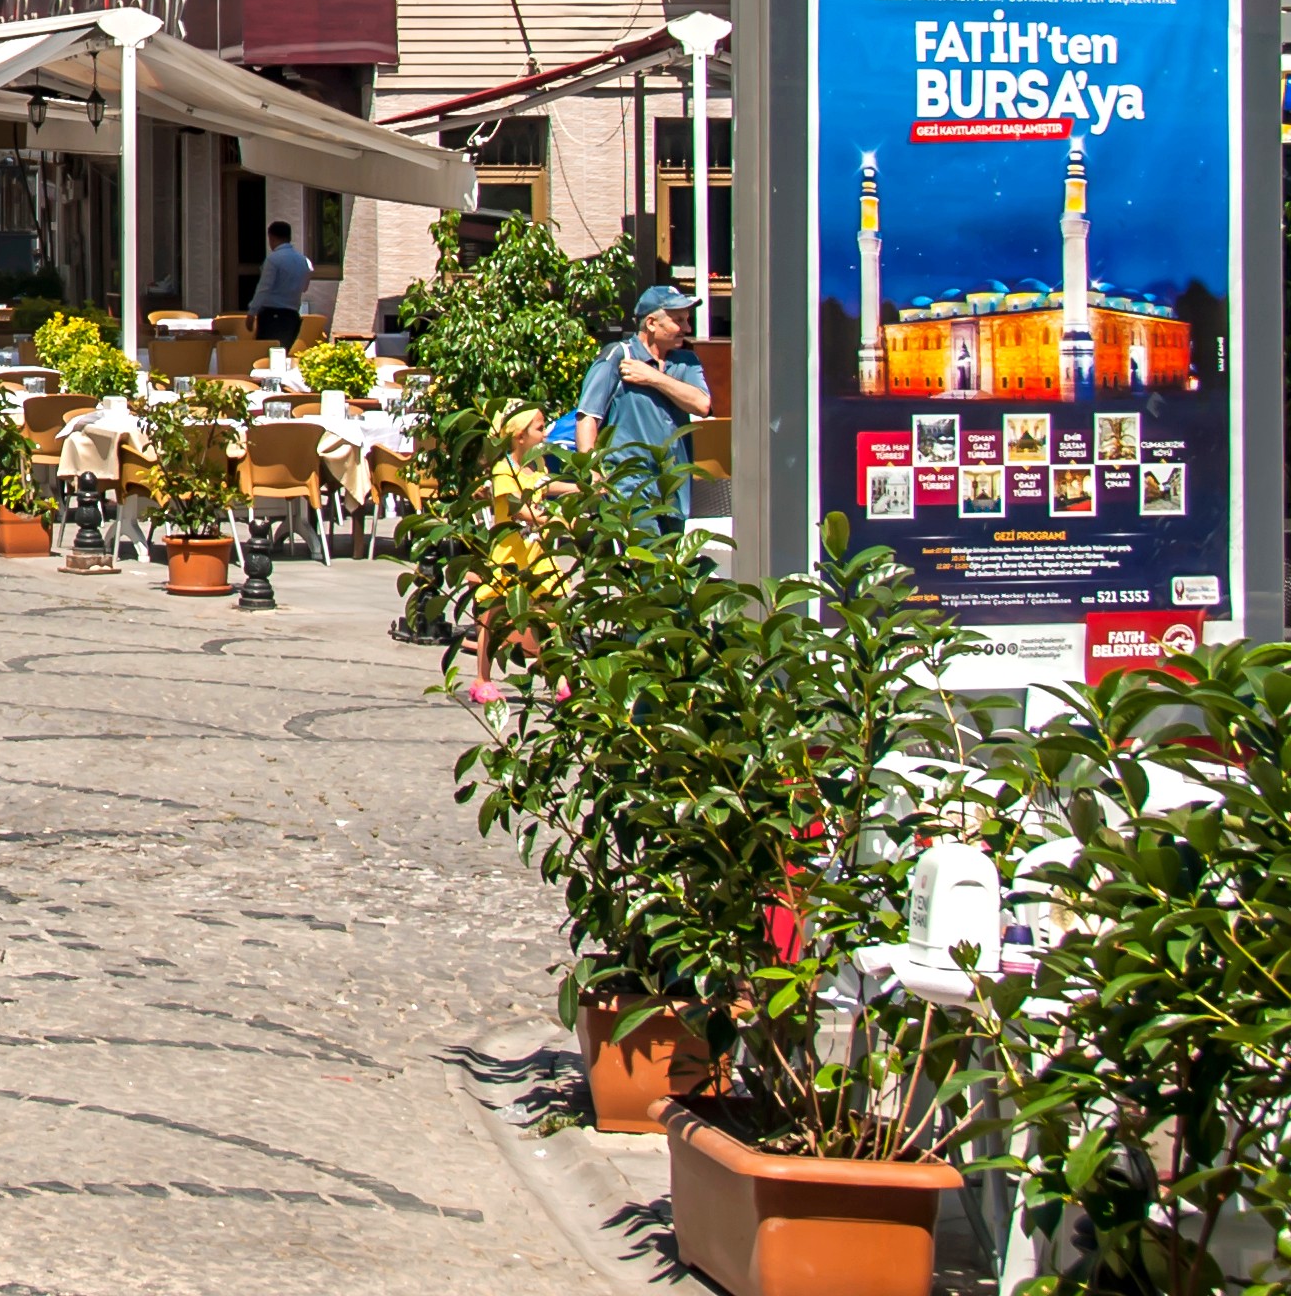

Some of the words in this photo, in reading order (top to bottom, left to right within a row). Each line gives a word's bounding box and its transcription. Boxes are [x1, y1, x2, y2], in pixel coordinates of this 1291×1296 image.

[915, 8, 1118, 64] FATİH'ten
[916, 68, 1145, 135] BURSA'ya
[916, 123, 938, 136] GEZİ
[1002, 122, 1063, 137] BAŞLAMIŞTIR
[994, 529, 1015, 541] GEZİ
[1096, 591, 1118, 603] 521
[1119, 590, 1150, 603] 5353
[1108, 631, 1146, 644] FATİH
